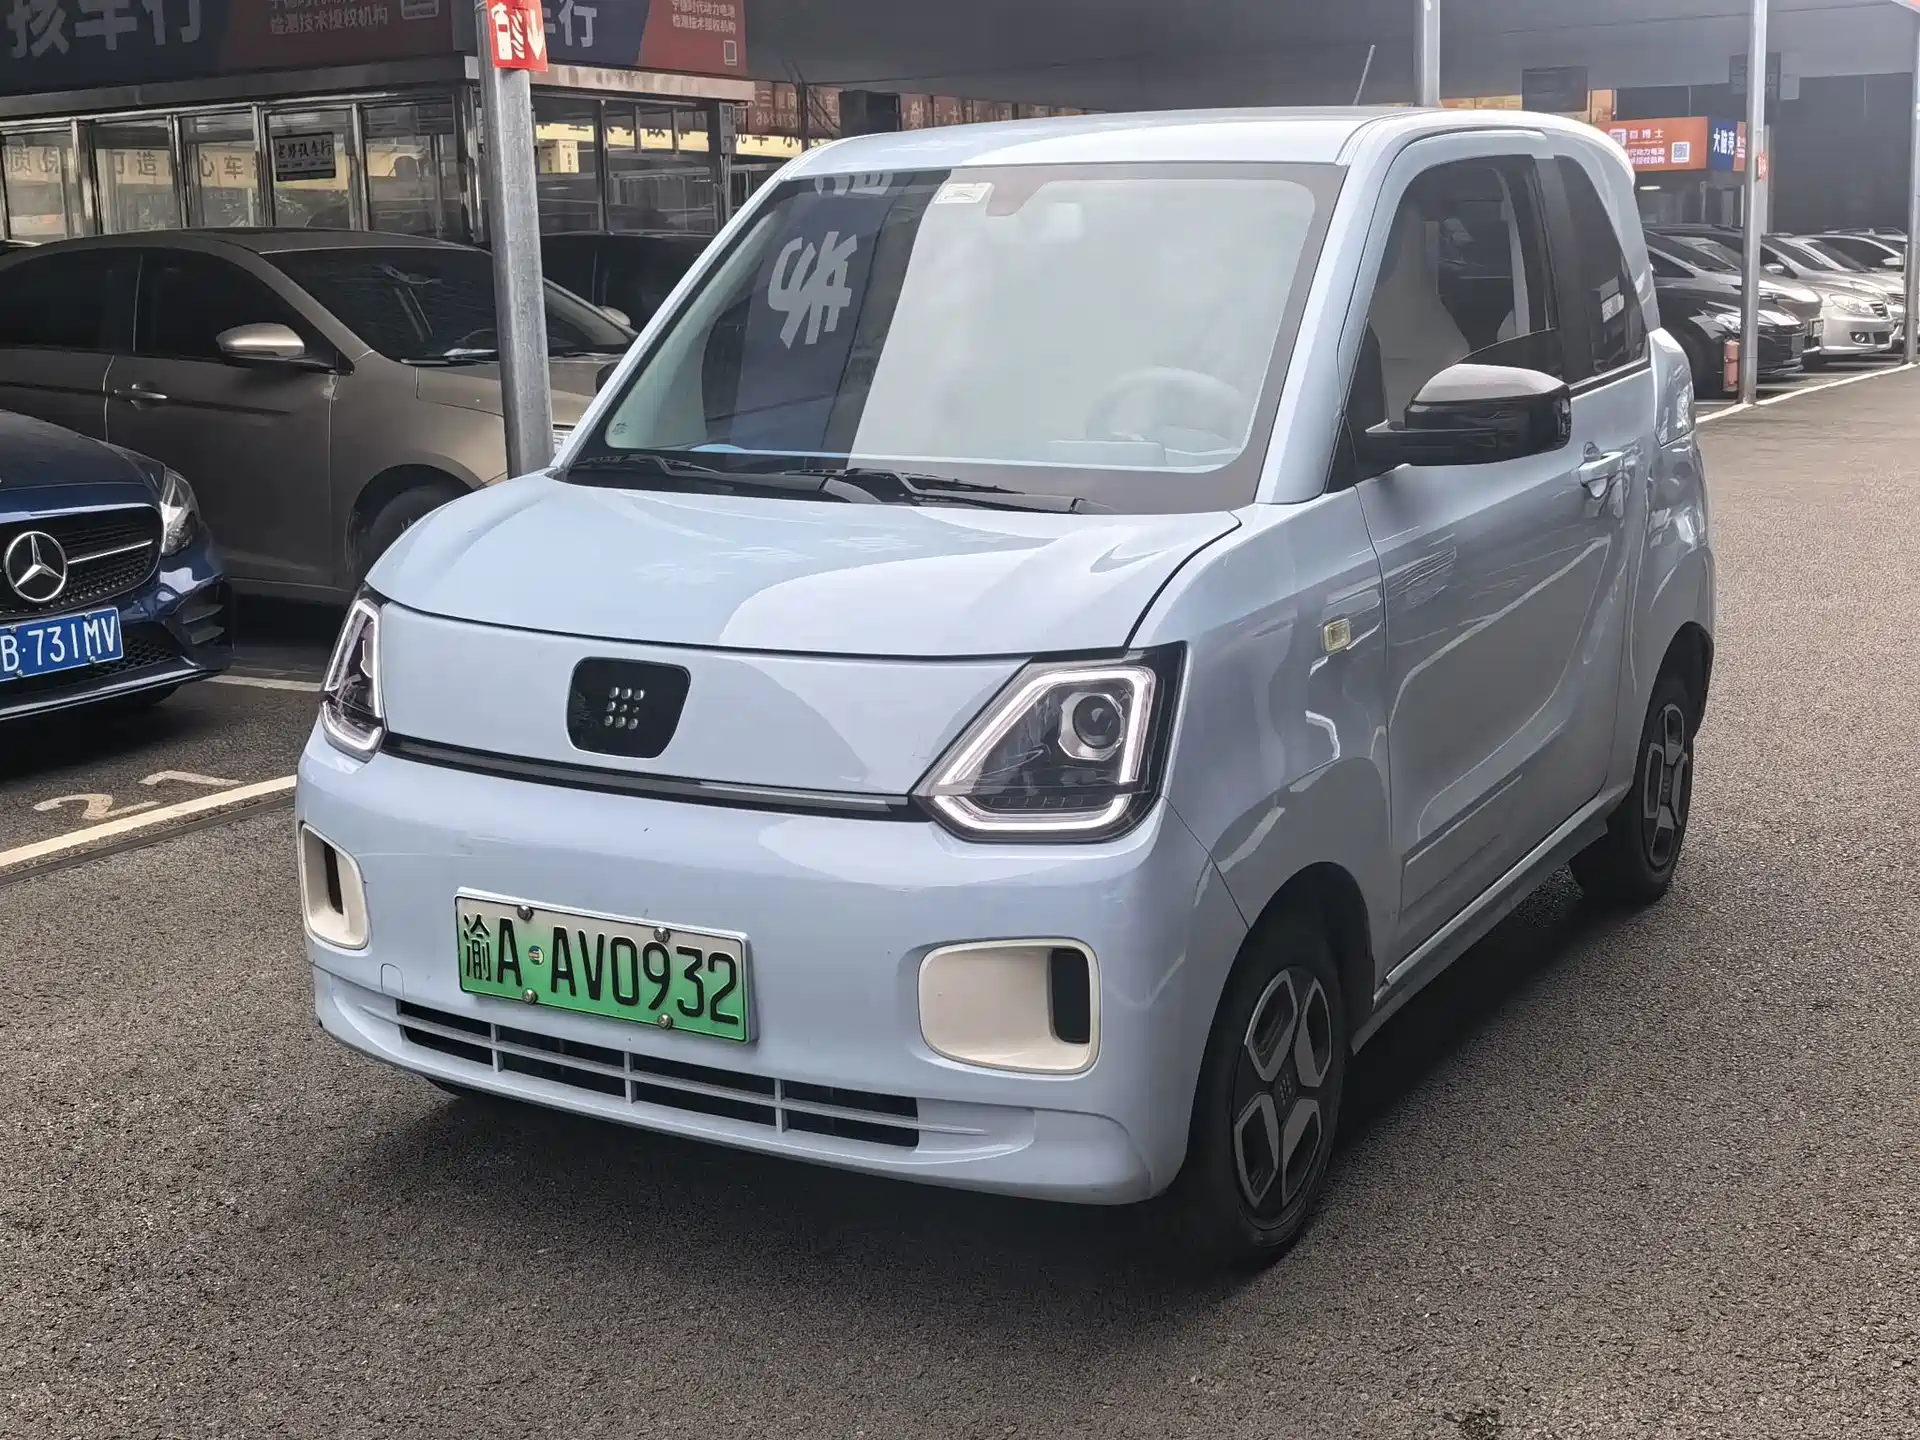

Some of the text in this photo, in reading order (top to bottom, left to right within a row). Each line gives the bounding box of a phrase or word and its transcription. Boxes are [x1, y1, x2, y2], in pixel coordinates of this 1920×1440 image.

[543, 0, 598, 48] 行
[462, 912, 740, 1026] 渝A AV0932
